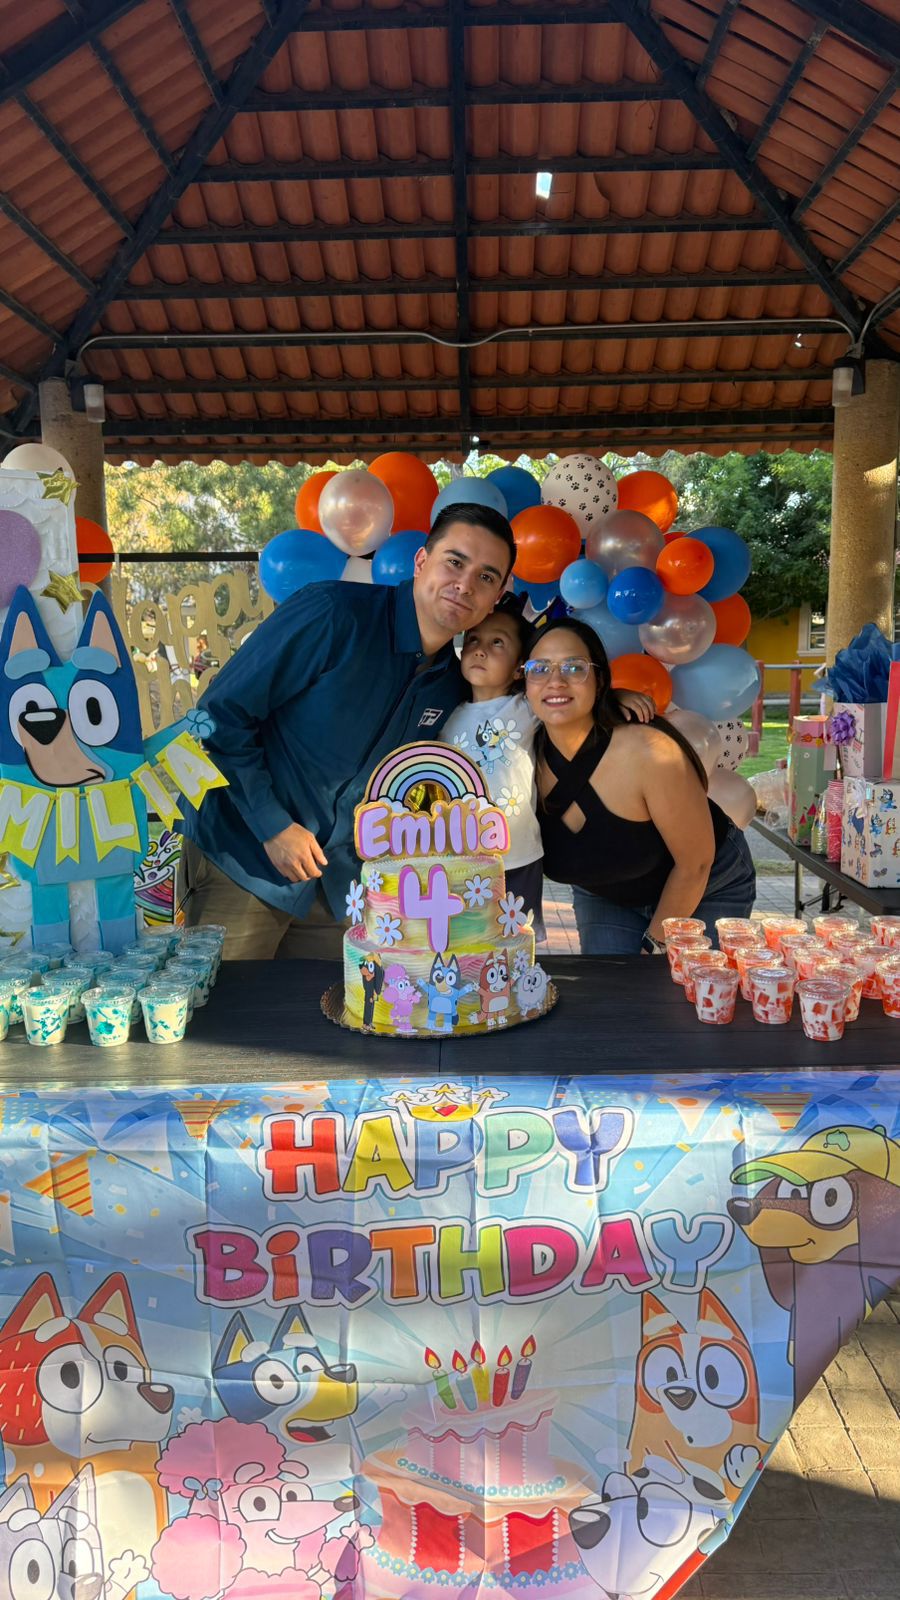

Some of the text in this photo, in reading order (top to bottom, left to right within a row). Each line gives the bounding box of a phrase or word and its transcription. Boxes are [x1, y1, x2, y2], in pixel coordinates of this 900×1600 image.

[358, 799, 508, 858] Emilia
[399, 864, 465, 953] 4
[264, 1106, 629, 1195] HAPPY
